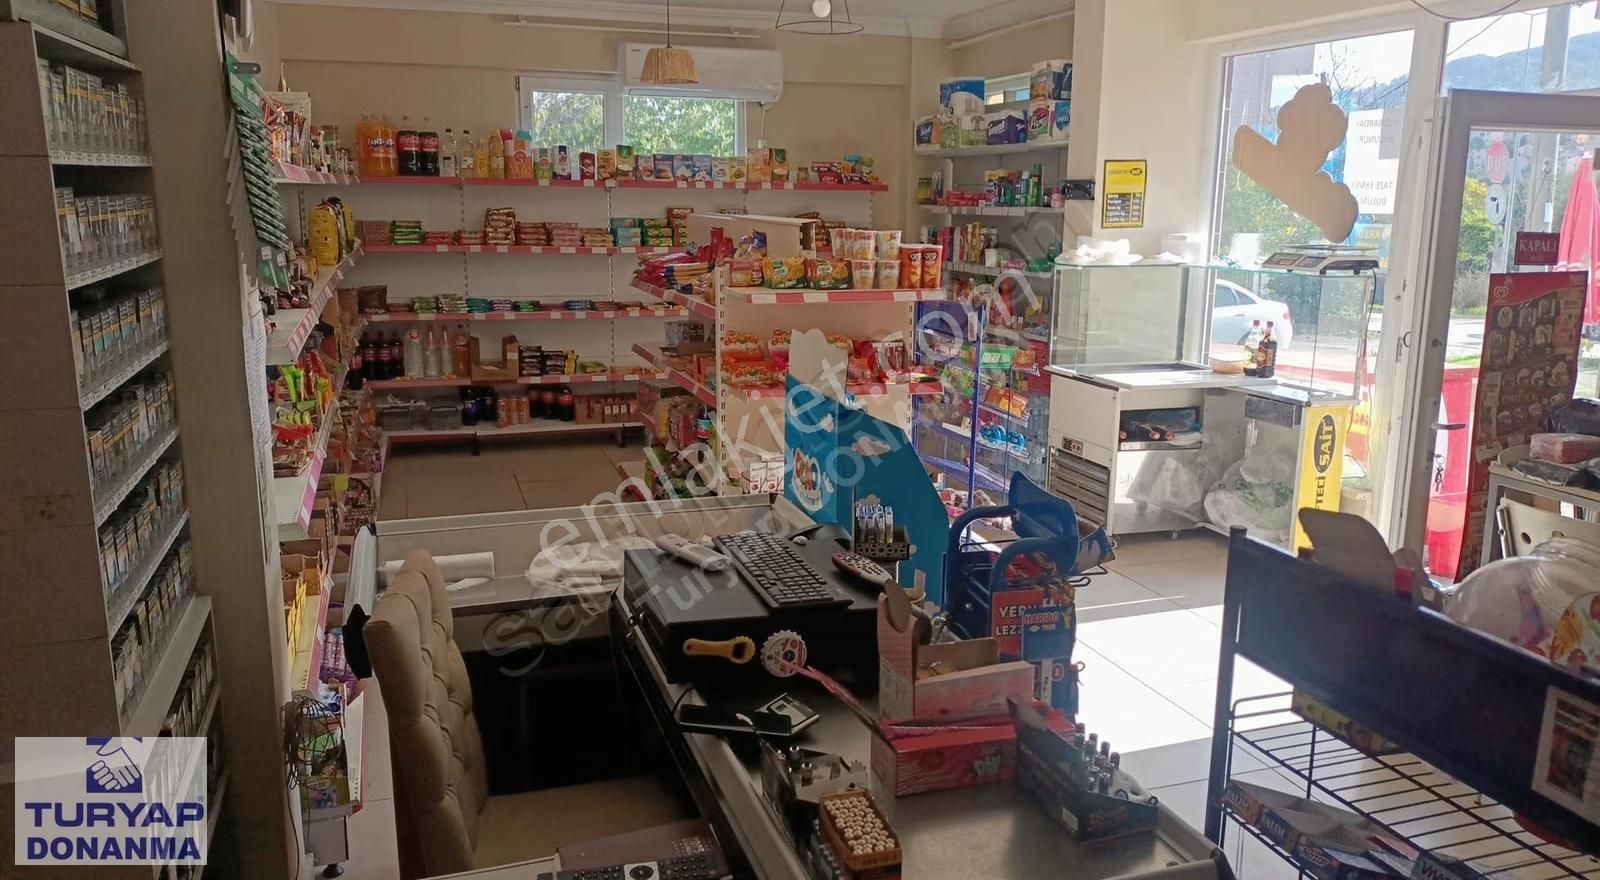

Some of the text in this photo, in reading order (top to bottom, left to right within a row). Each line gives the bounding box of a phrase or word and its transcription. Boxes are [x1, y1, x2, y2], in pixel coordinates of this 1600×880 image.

[1519, 239, 1557, 253] KAPALI
[1314, 419, 1334, 513] TECİ SAİT
[1024, 611, 1060, 625] HARIBO
